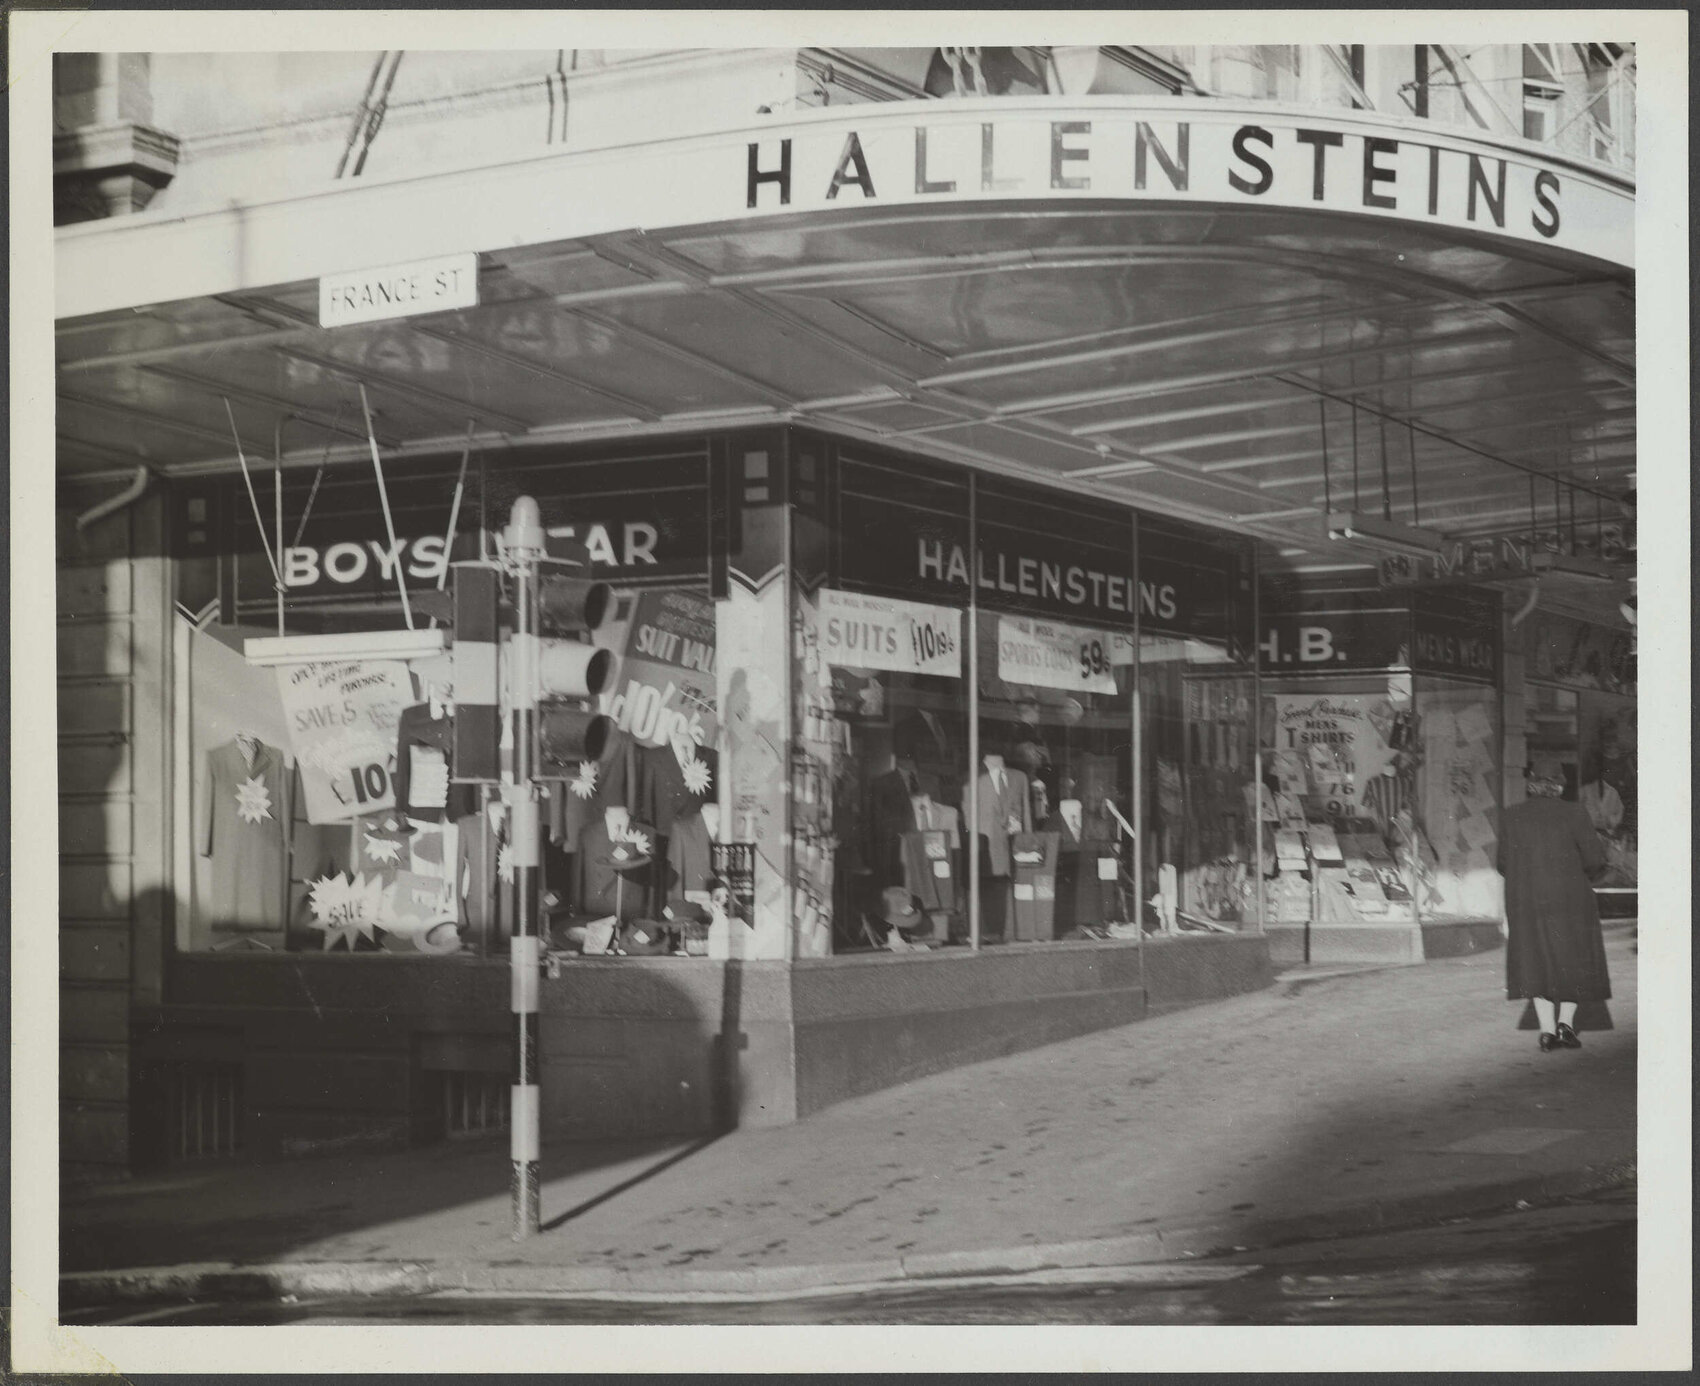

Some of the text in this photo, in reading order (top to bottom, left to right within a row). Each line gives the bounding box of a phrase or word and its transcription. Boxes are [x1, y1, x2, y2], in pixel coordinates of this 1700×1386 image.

[746, 121, 1561, 238] HALLENSTEINS
[330, 268, 463, 313] FRANCE ST
[284, 522, 658, 587] BOYS AR
[918, 539, 1177, 620] HALLENSTEINS
[636, 624, 681, 662] SUIT
[827, 617, 897, 655] SUITS
[294, 704, 336, 732] SAVE
[1286, 727, 1355, 748] T SHIRTS
